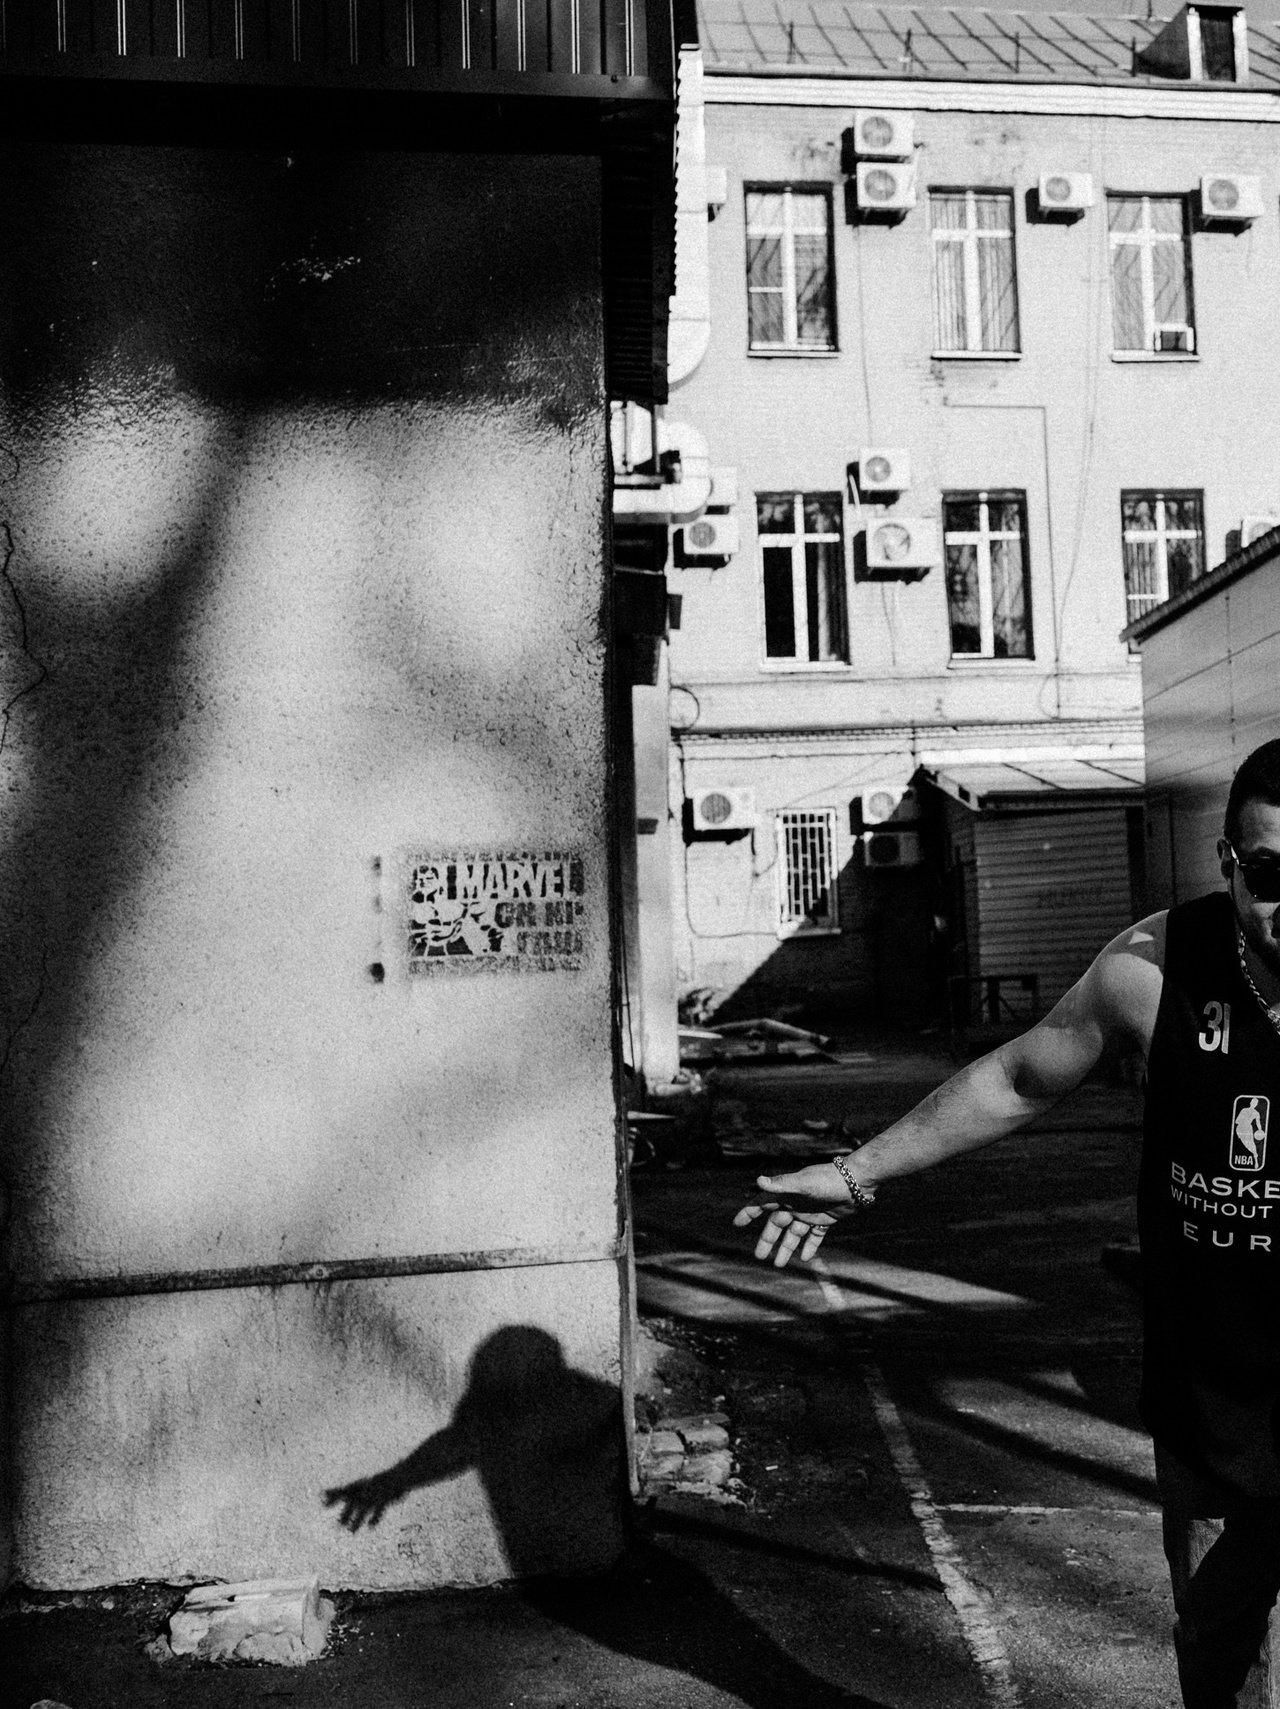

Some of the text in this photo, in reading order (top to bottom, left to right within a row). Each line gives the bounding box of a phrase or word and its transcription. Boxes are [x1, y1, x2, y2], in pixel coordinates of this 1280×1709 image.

[459, 862, 577, 899] MARVEL
[1198, 1001, 1231, 1054] 31
[1234, 1155, 1254, 1166] NBA
[1170, 1184, 1273, 1219] WITHOUT
